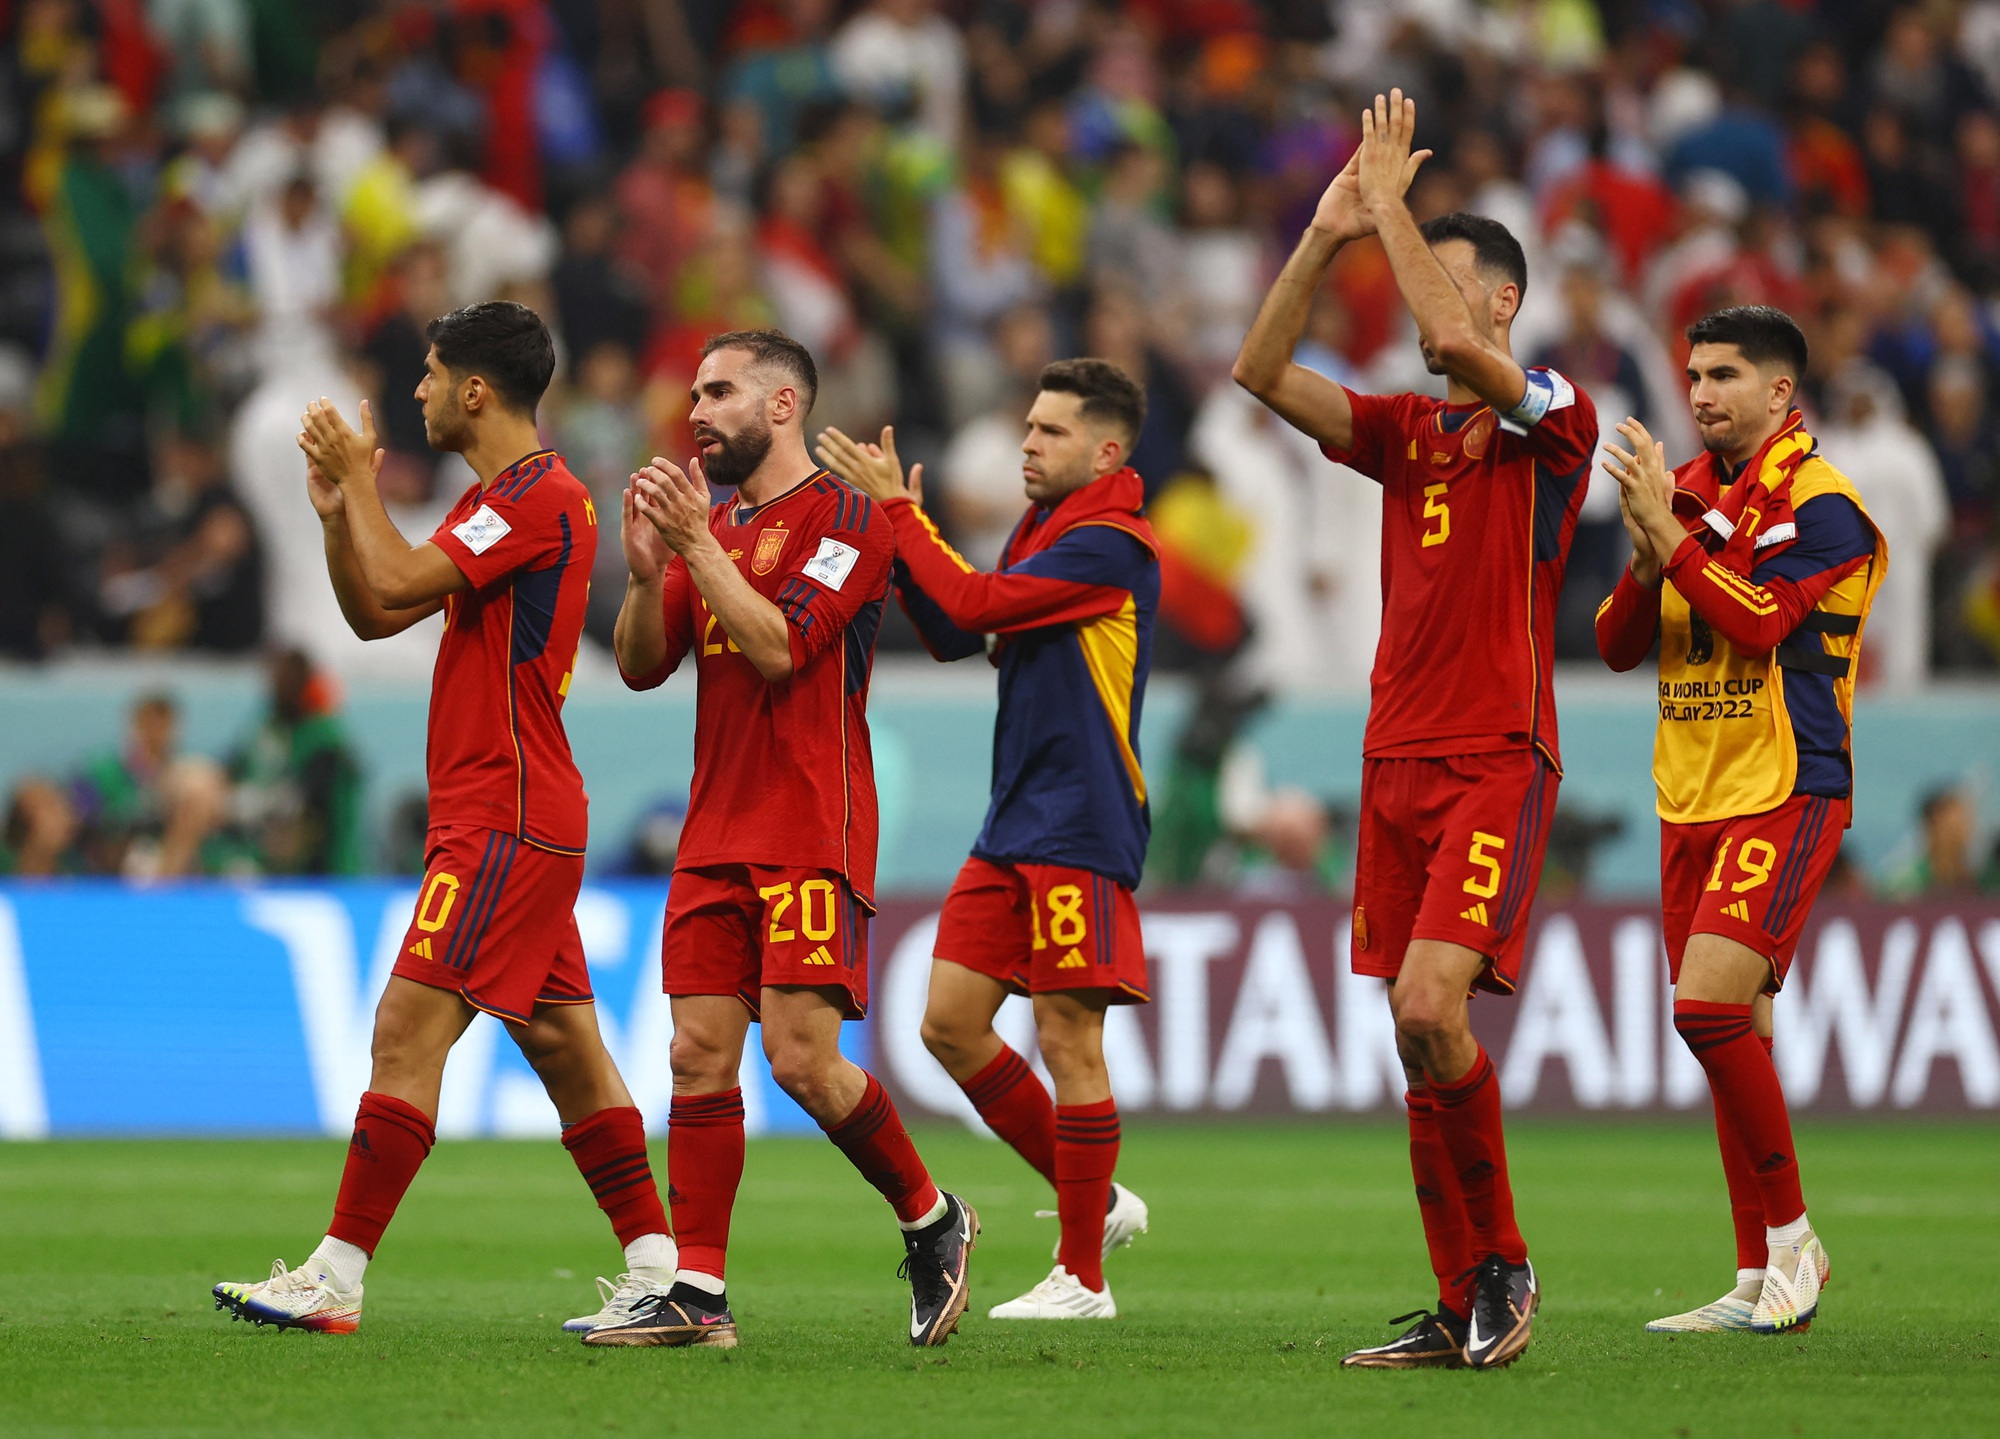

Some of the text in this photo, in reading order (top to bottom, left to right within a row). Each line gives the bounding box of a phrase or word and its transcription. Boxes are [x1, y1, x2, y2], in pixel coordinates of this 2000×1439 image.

[1422, 483, 1450, 548] 5
[1724, 678, 1764, 696] CUP
[1463, 831, 1505, 899] 5
[1705, 837, 1777, 893] 19
[416, 871, 460, 933] 0
[759, 879, 835, 943] 20
